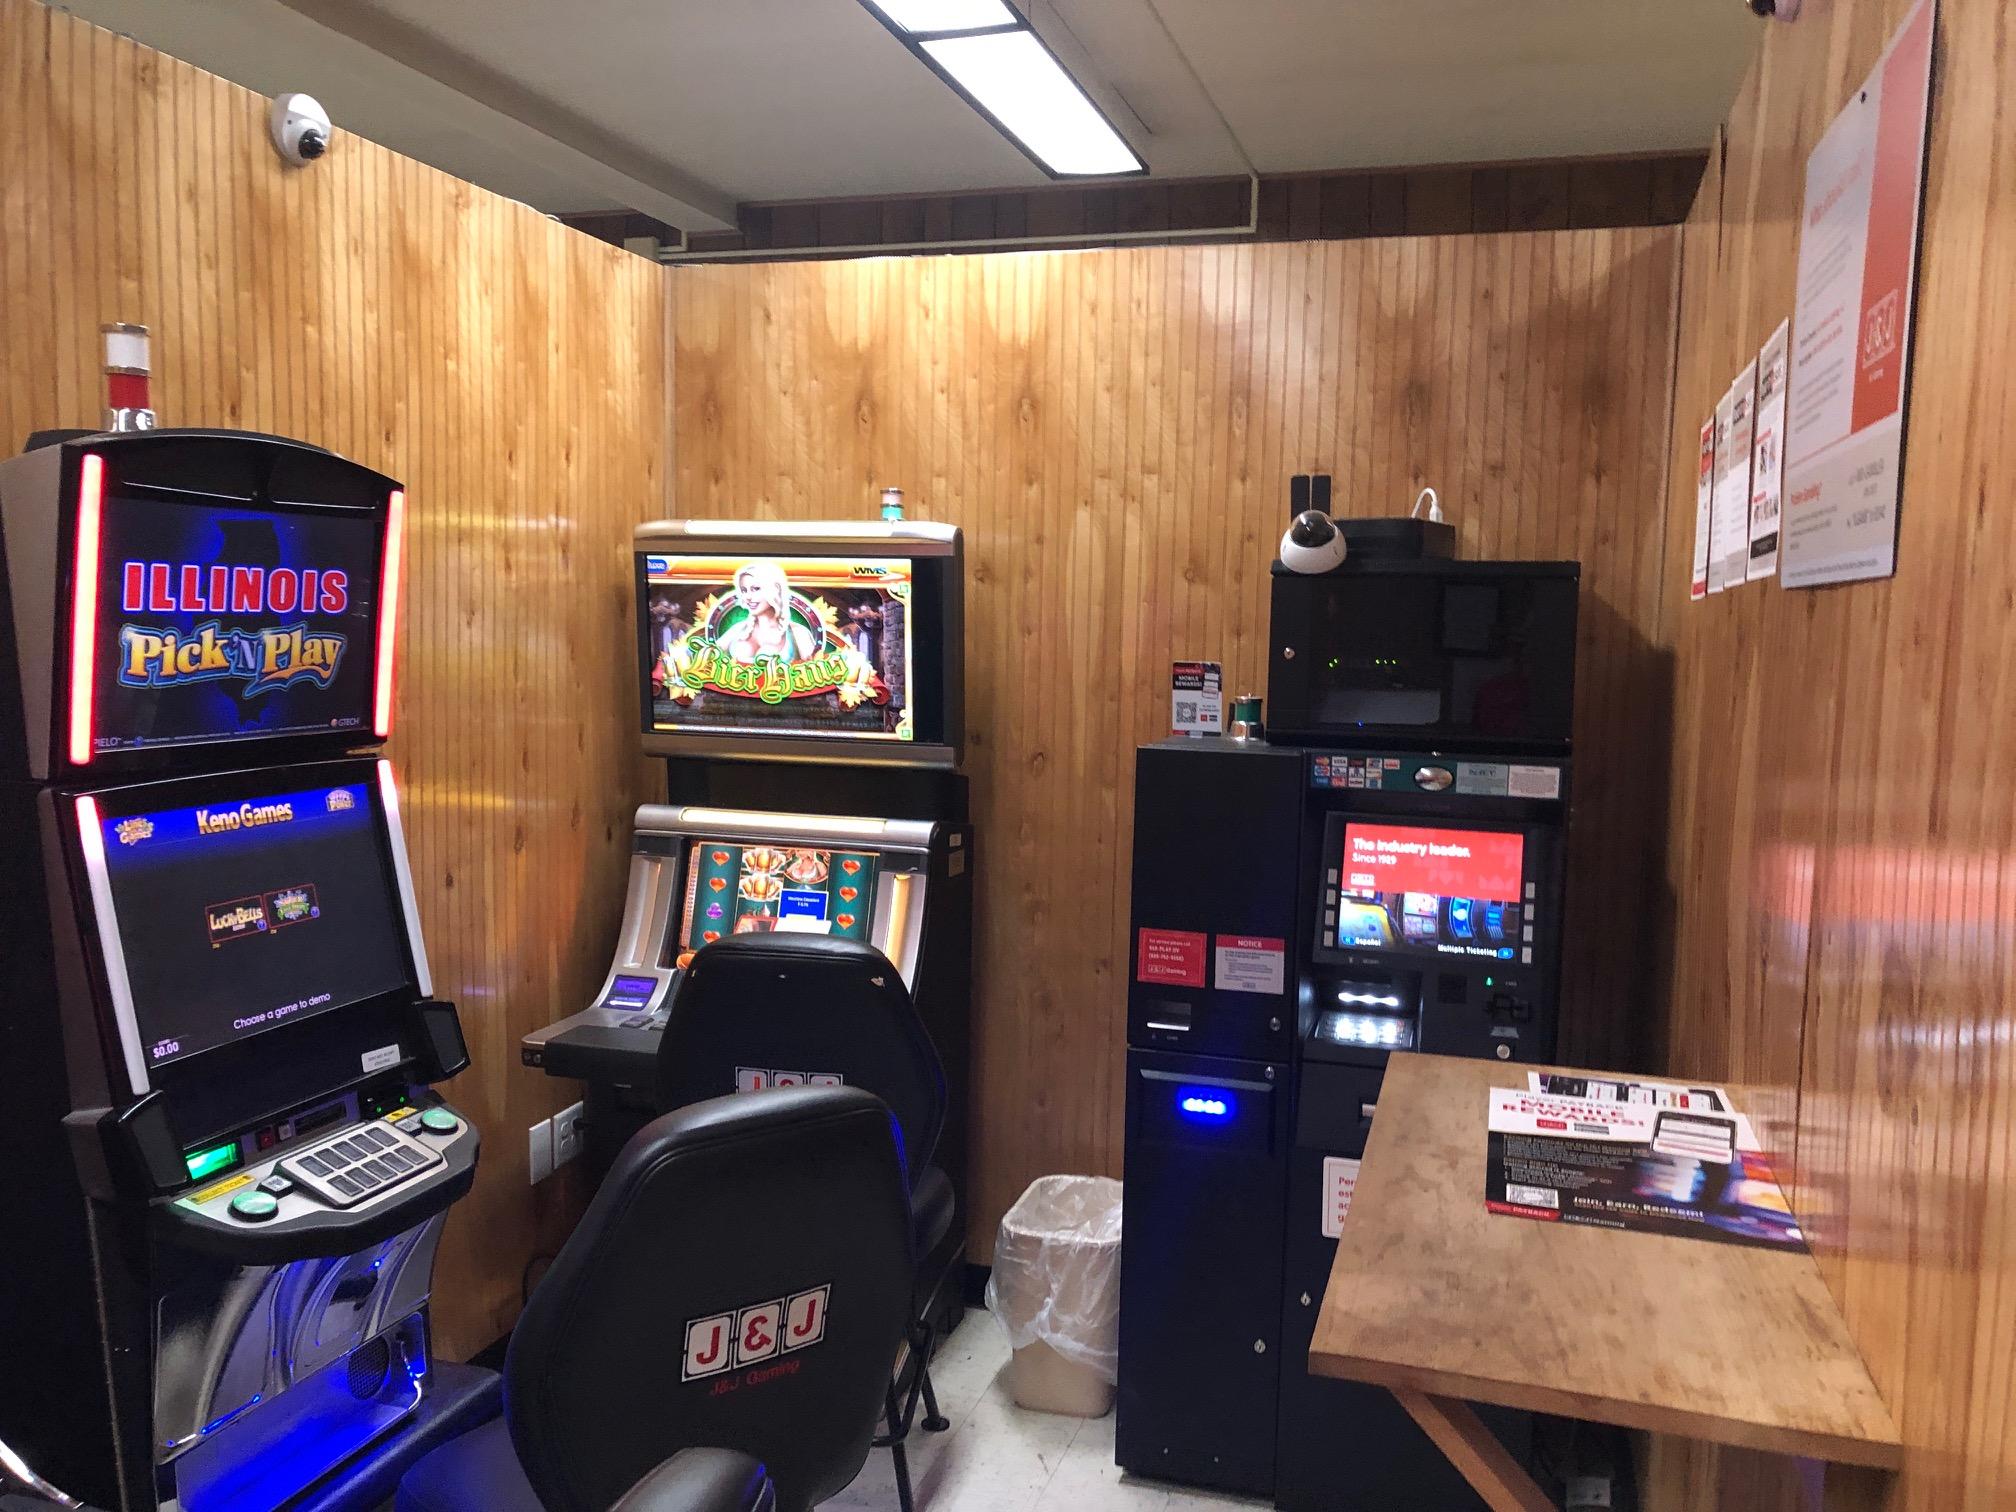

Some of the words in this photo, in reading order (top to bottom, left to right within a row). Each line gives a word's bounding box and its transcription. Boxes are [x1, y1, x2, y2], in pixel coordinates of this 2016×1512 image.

[123, 562, 348, 613] ILLINOIS
[125, 628, 229, 677] Pick
[261, 629, 342, 682] Play
[683, 637, 761, 692] Bier
[755, 653, 849, 704] Haus
[338, 718, 359, 727] GTECH
[196, 810, 240, 834] Keno
[240, 803, 293, 828] Games
[1353, 838, 1375, 851] The
[1352, 853, 1376, 864] Since
[1237, 940, 1263, 948] NOTICE
[1436, 944, 1465, 954] Multiple
[1466, 947, 1498, 957] Ticketing
[233, 1013, 265, 1029] Choose
[267, 1011, 273, 1019] a
[275, 1003, 298, 1018] game
[299, 1000, 307, 1009] to
[309, 993, 331, 1006] demo
[153, 1041, 179, 1058] $0.00
[695, 1298, 817, 1366] J&J
[746, 1360, 800, 1386] Gaming
